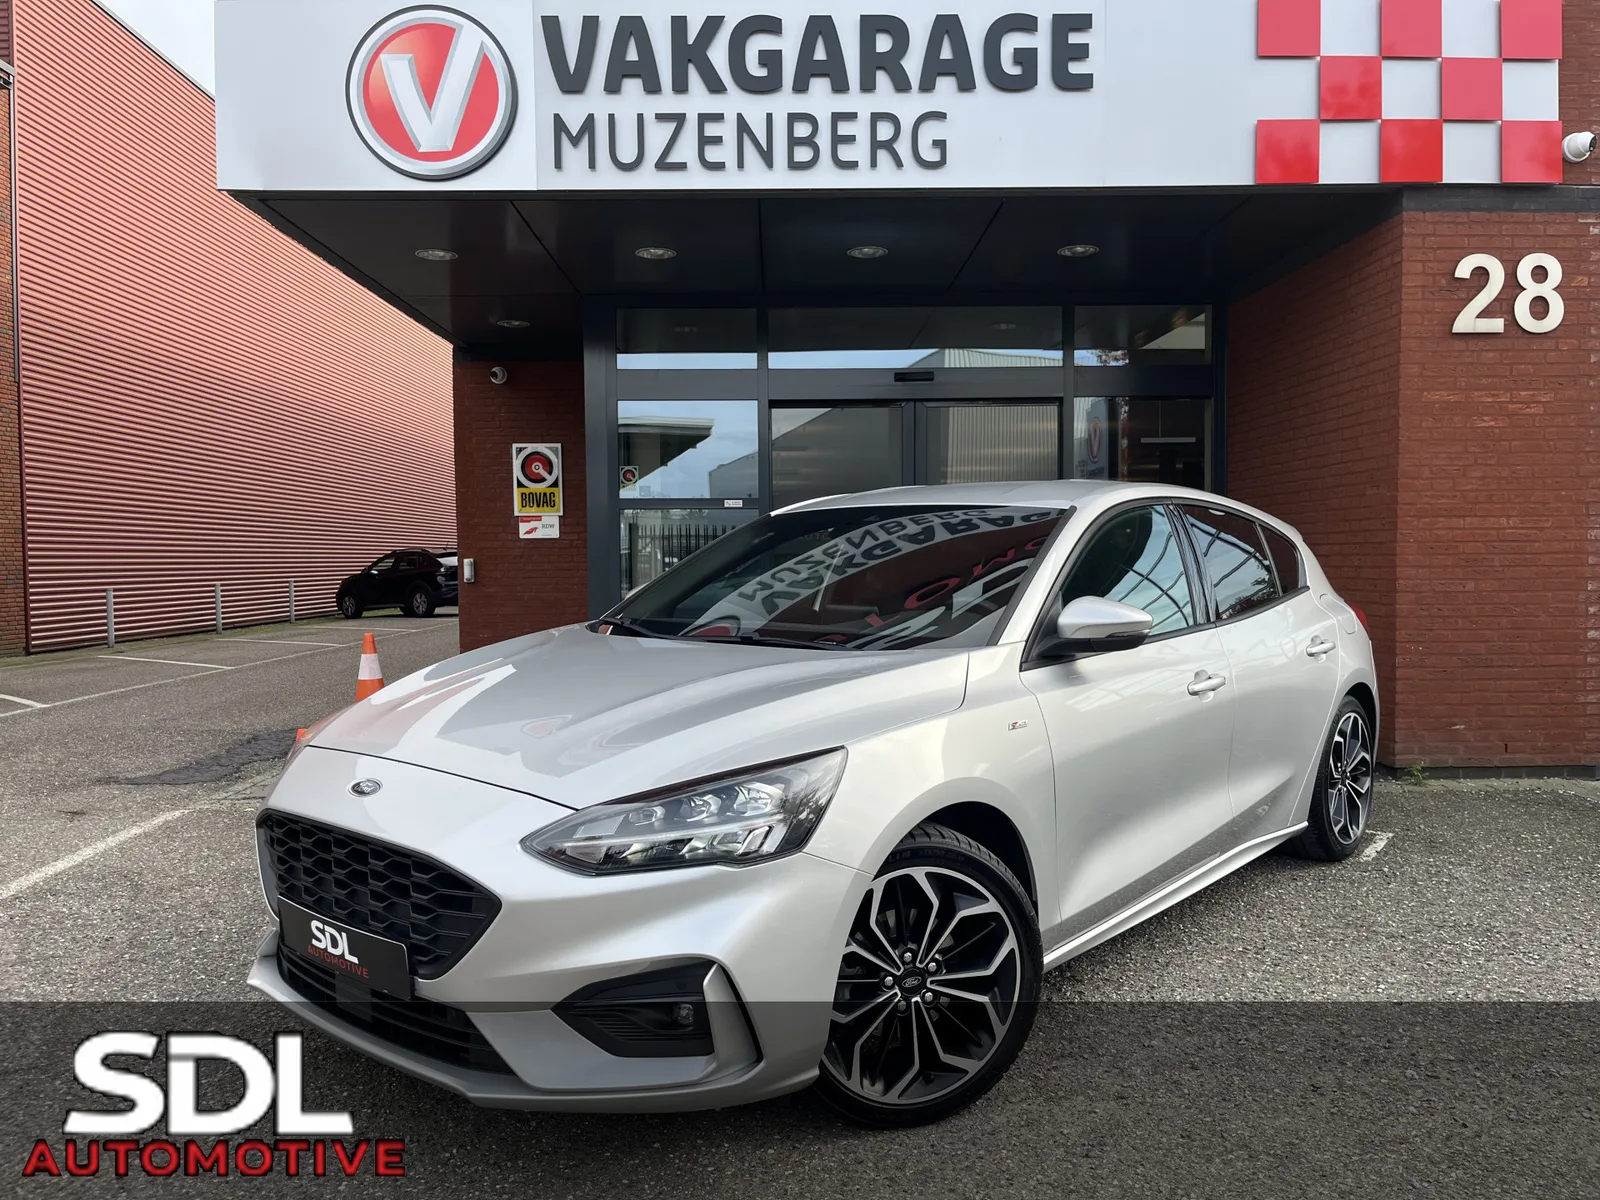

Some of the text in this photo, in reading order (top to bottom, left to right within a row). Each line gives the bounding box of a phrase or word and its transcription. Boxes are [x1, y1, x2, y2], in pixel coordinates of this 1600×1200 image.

[540, 13, 1095, 94] VAKGARAGE
[380, 24, 484, 153] V
[553, 110, 949, 171] MUZENBERG
[1452, 253, 1565, 334] 28
[520, 491, 556, 508] BOVAG
[307, 944, 369, 978] AUTOMOTIVE
[310, 919, 359, 964] SDL
